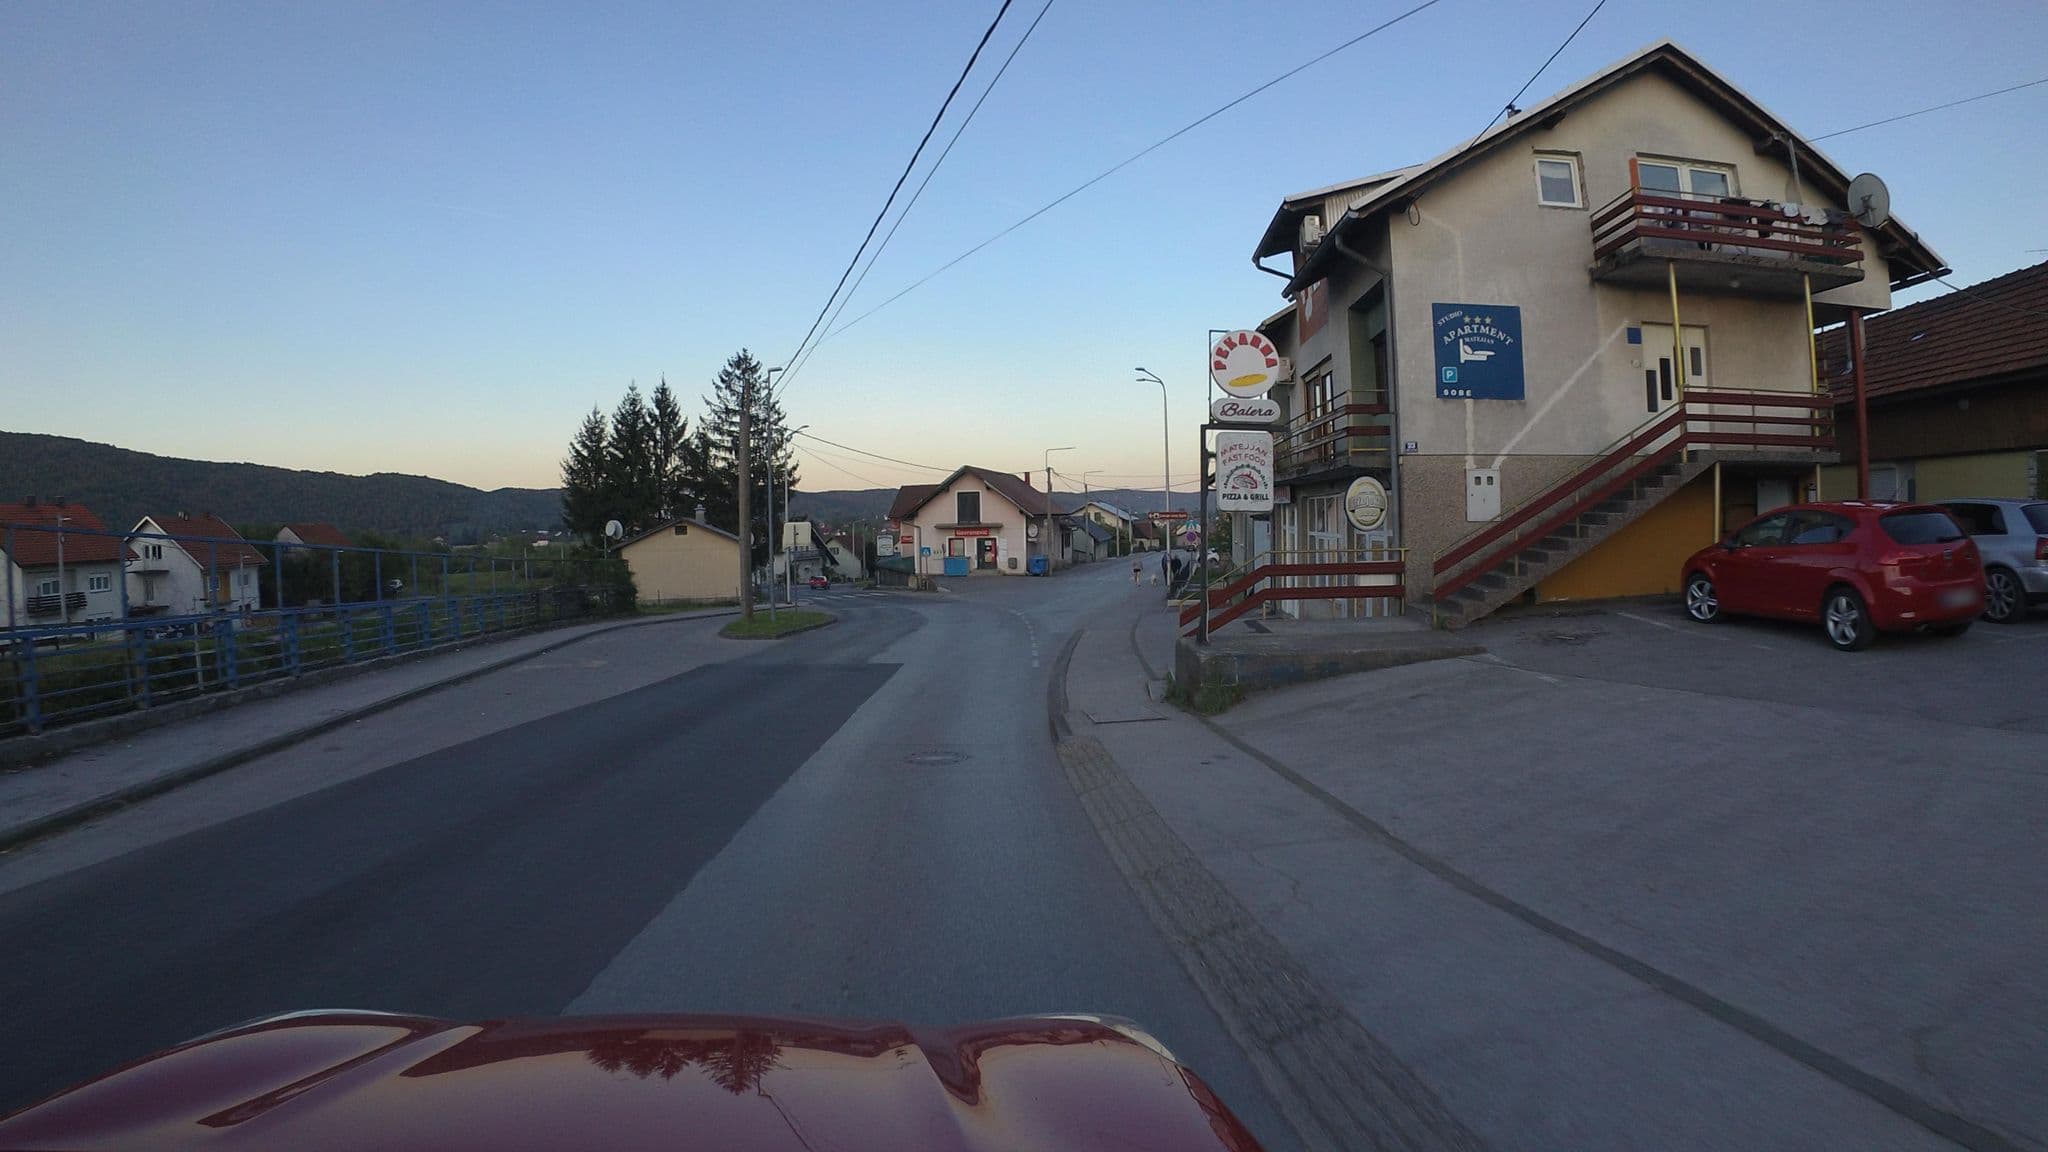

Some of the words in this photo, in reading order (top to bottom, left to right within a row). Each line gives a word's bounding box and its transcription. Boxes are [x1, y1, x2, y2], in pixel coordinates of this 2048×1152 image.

[1437, 310, 1463, 327] STUDIO
[1443, 324, 1514, 346] APARTMENT
[1446, 370, 1454, 380] P
[1443, 389, 1472, 397] SOBE
[1223, 453, 1243, 466] FAST
[1244, 453, 1266, 466] FOOD
